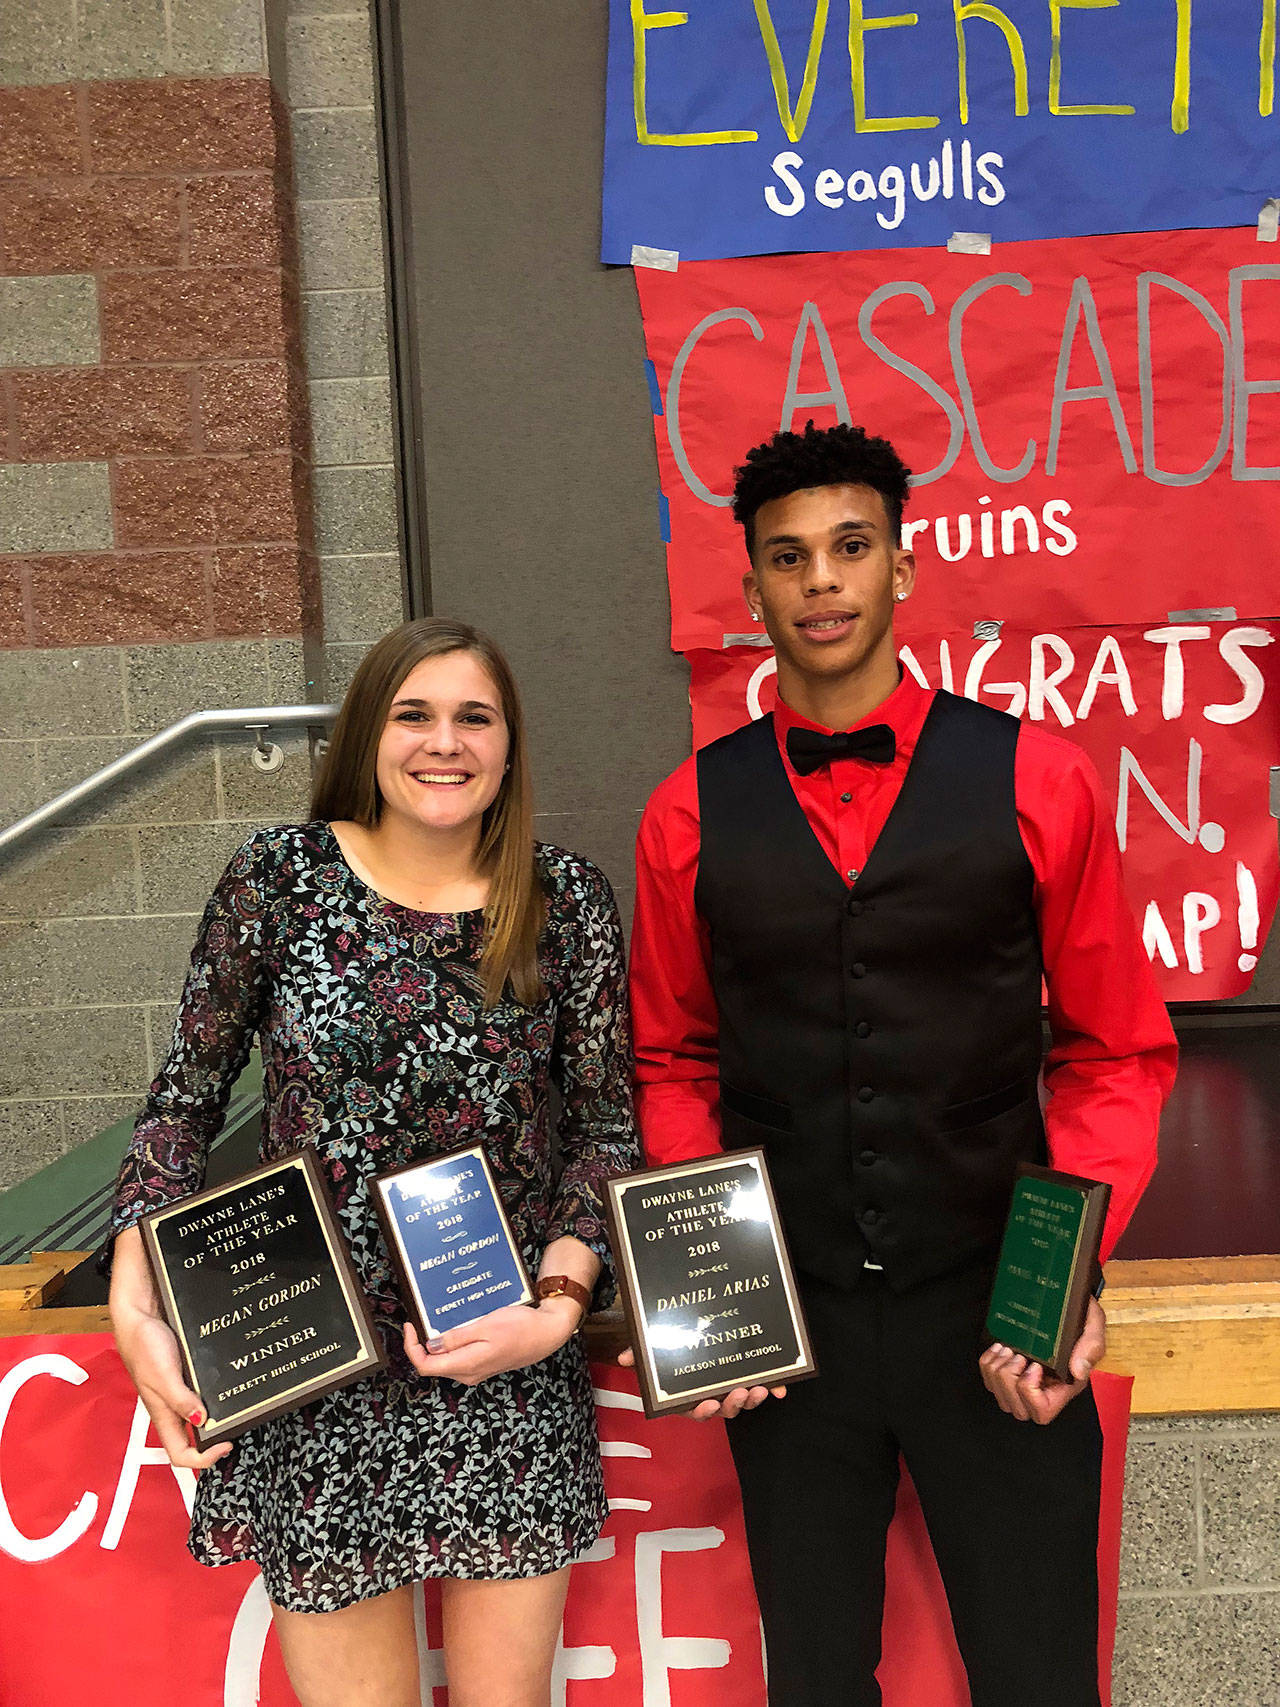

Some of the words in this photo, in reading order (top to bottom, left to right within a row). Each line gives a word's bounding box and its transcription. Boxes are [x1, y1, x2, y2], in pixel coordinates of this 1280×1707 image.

[765, 139, 1005, 229] Seagulls
[667, 264, 1280, 507] CASCADE
[901, 496, 1078, 562] ruins
[747, 626, 1276, 727] CNGRATS
[179, 1206, 235, 1238] DWAYNE
[239, 1184, 286, 1212] LANE'S
[405, 1212, 421, 1223] OF
[424, 1201, 449, 1216] THE
[451, 1189, 482, 1206] YEAR
[641, 1188, 694, 1210] DWAYNE
[698, 1178, 741, 1200] LANE'S
[667, 1201, 727, 1222] ATHLETE
[205, 1210, 270, 1246] ATHLETE
[436, 1214, 464, 1230] 2018
[644, 1227, 665, 1242] OF
[669, 1219, 704, 1236] THE
[183, 1252, 205, 1270] OF
[210, 1236, 247, 1259] THE
[251, 1213, 299, 1243] YEAR
[419, 1250, 455, 1272] MEGAN
[458, 1232, 500, 1256] GORDON
[687, 1240, 721, 1258] 2018
[230, 1252, 267, 1275] 2018
[446, 1270, 494, 1294] CANDIDATE
[199, 1303, 254, 1339] MEGAN
[258, 1273, 321, 1312] GORDON
[435, 1299, 465, 1316] EVERETT
[485, 1280, 513, 1296] SCHOOL
[657, 1286, 716, 1313] DANIEL
[723, 1274, 771, 1297] ARIAS
[229, 1326, 318, 1372] WINNER
[674, 1359, 716, 1377] JACKSON
[718, 1352, 743, 1367] HIGH
[745, 1344, 782, 1358] SCHOOL
[218, 1372, 268, 1402] EVERETT
[270, 1358, 299, 1379] HIGH
[299, 1341, 342, 1368] SCHOOL
